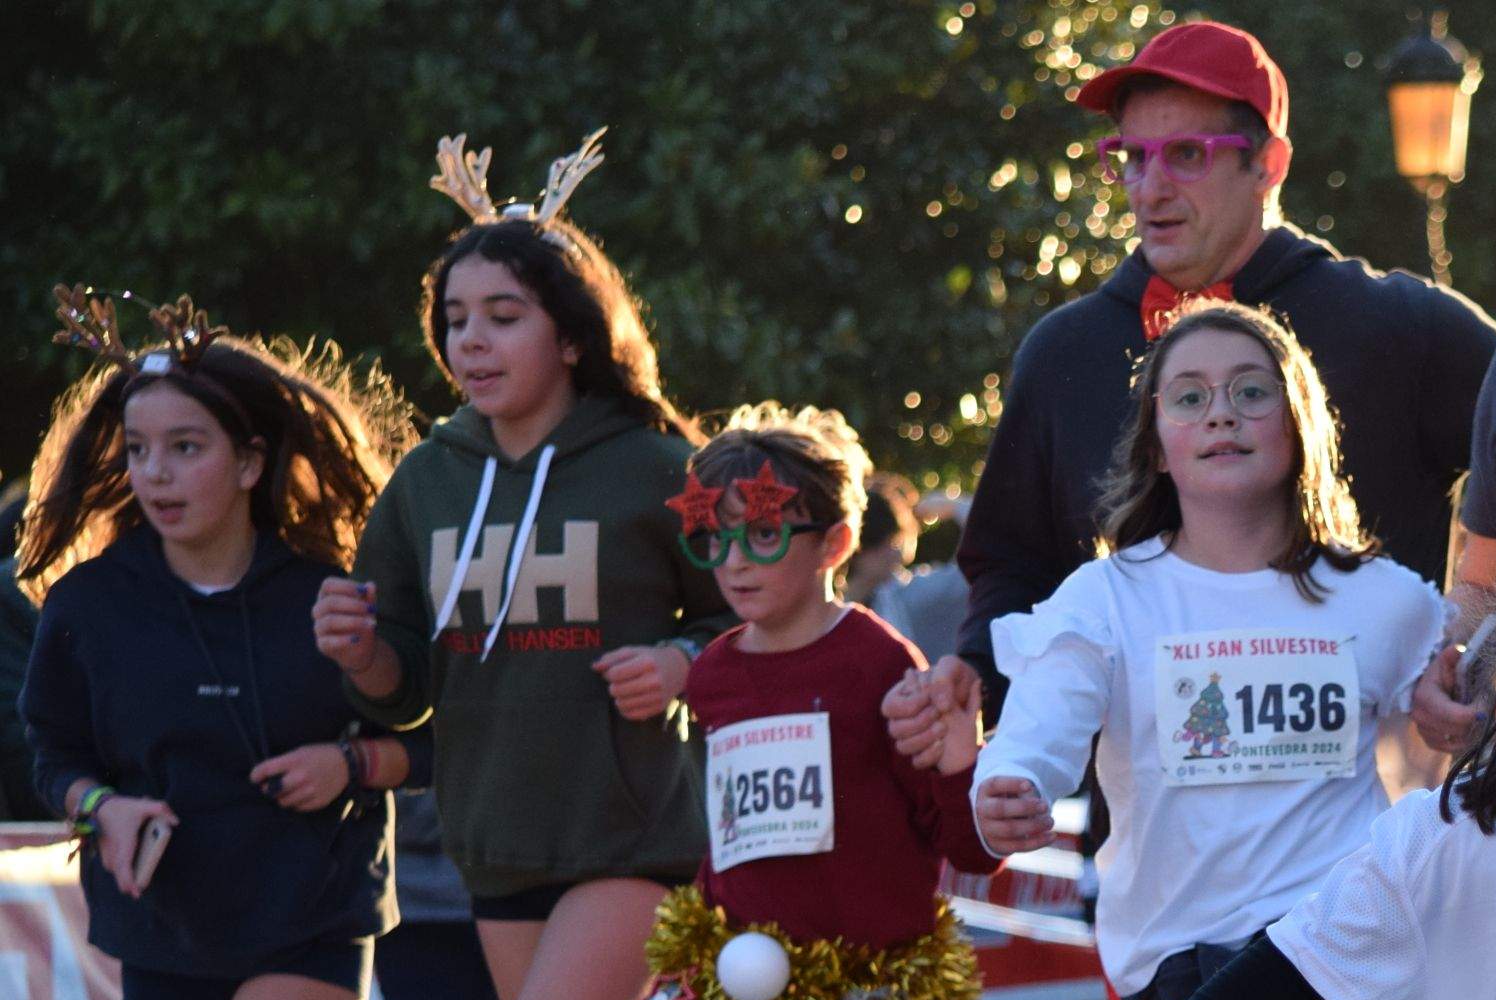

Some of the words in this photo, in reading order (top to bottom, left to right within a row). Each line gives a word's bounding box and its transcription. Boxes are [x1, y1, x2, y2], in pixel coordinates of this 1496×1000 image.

[430, 519, 599, 628] HH
[507, 626, 603, 652] HANSEN
[1173, 643, 1200, 660] XLI
[1207, 639, 1243, 657] SAN
[1251, 637, 1339, 656] SILVESTRE
[1235, 682, 1346, 734] 1436
[745, 725, 812, 745] SILVESTRE
[1233, 742, 1308, 758] PONTEVEDRA
[1311, 742, 1343, 755] 2024
[736, 765, 823, 818] 2564
